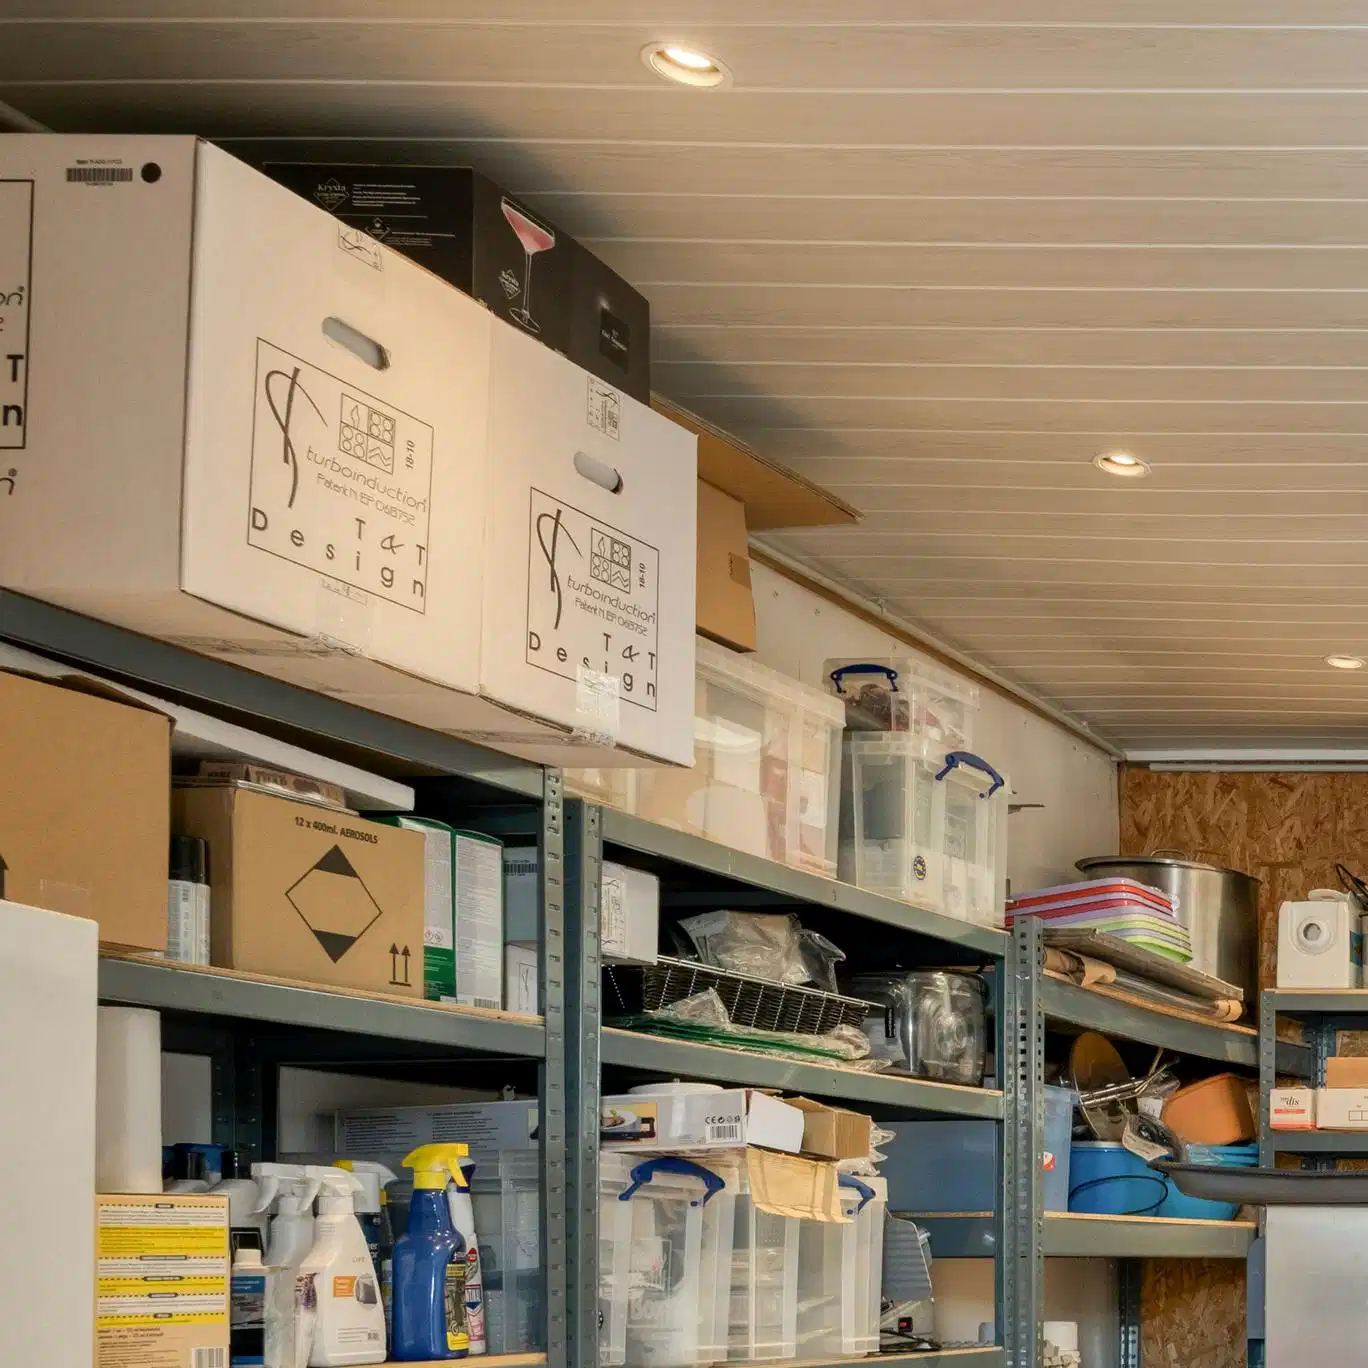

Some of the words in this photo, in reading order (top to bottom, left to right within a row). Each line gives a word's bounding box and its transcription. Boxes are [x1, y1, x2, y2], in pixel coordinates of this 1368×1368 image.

[307, 445, 426, 513] turboinduction
[251, 506, 424, 598] Design
[567, 575, 656, 625] turboinduction
[295, 816, 304, 827] 12
[306, 820, 311, 828] x
[340, 827, 379, 845] AEROSOLS
